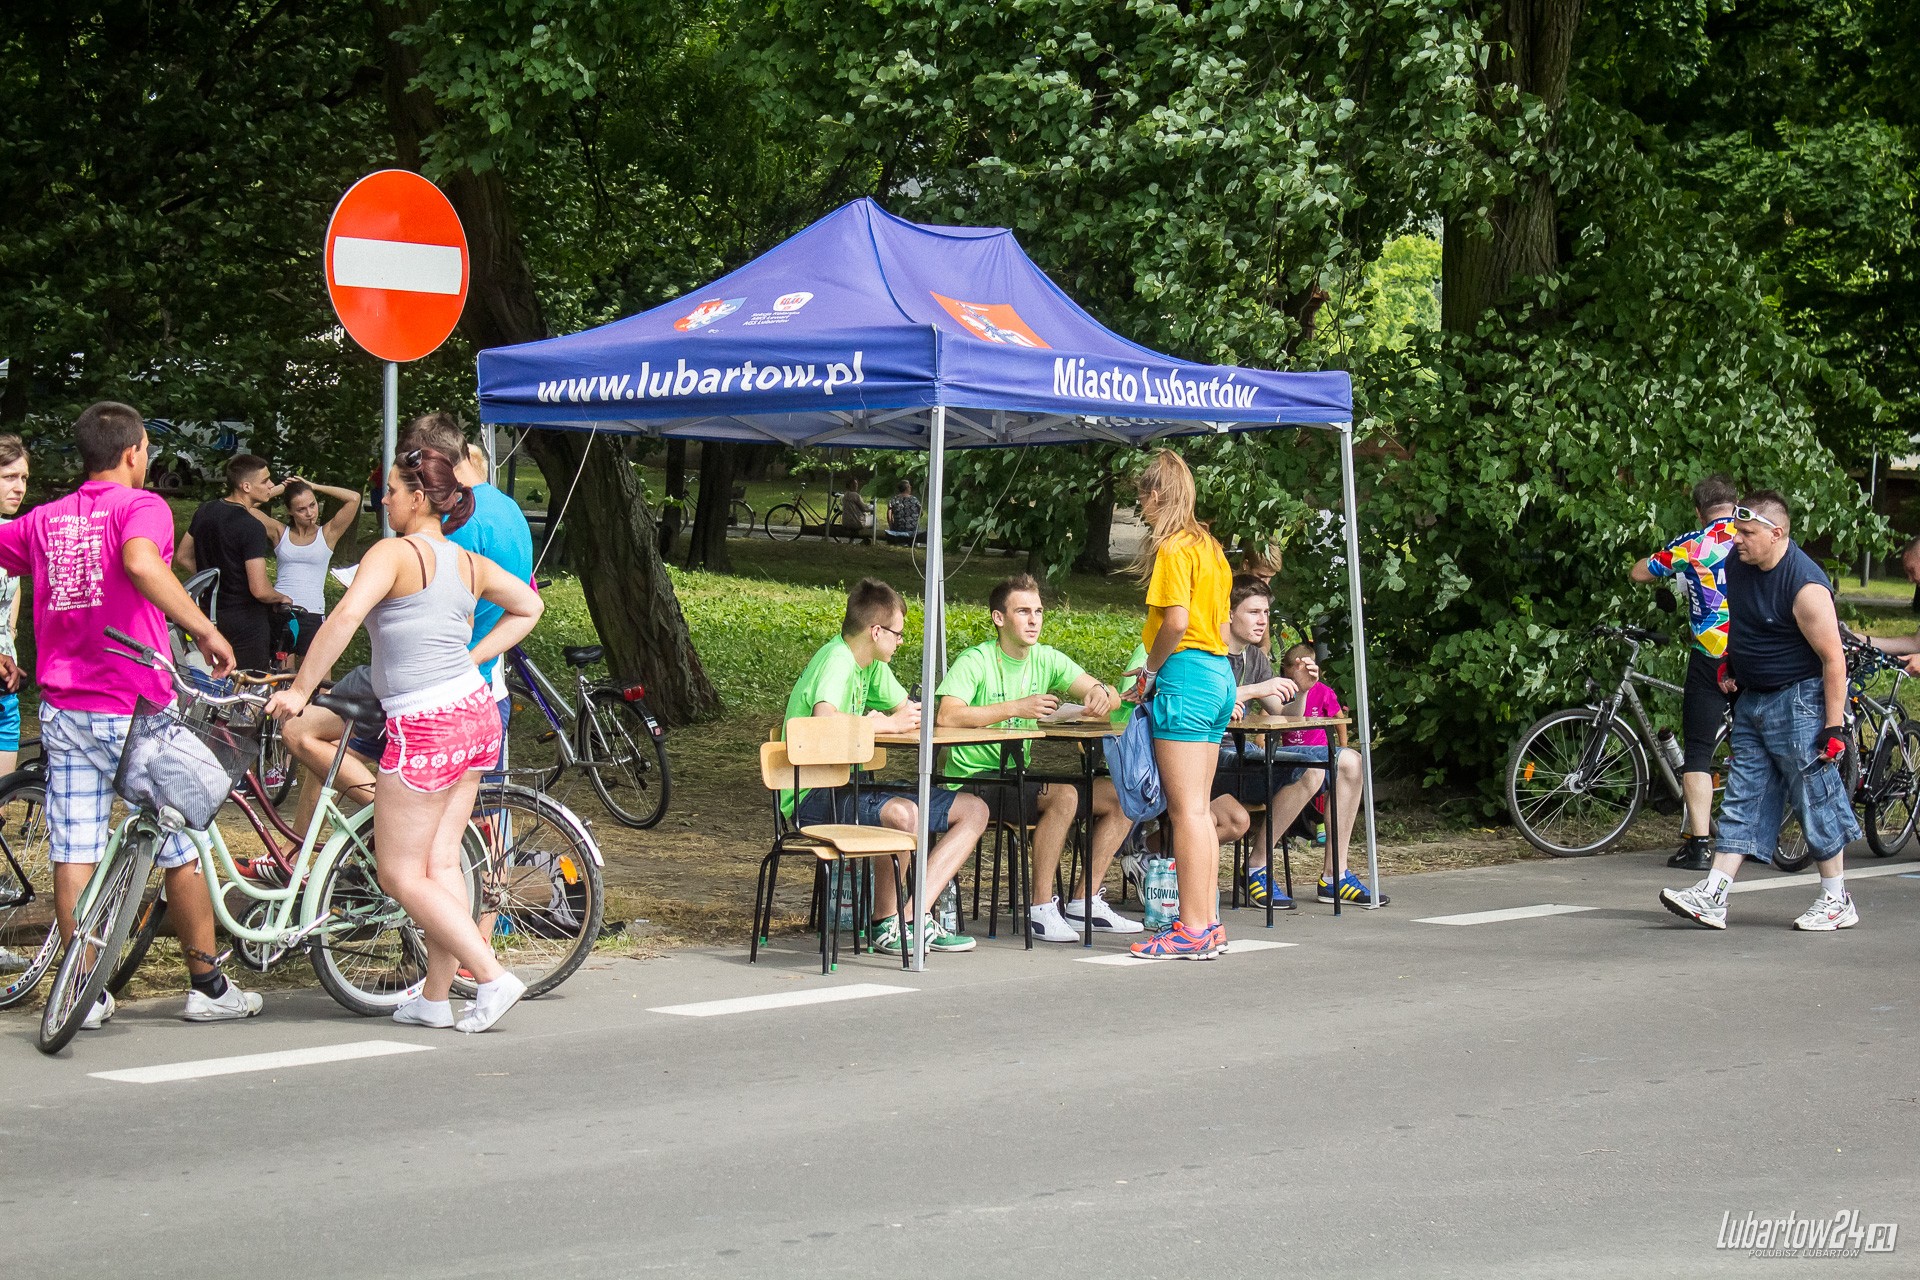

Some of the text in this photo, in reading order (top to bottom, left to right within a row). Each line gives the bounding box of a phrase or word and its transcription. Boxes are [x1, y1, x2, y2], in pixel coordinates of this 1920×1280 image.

[537, 351, 865, 403] www.lubartow.pl
[1053, 357, 1260, 409] Miasto Lubartów
